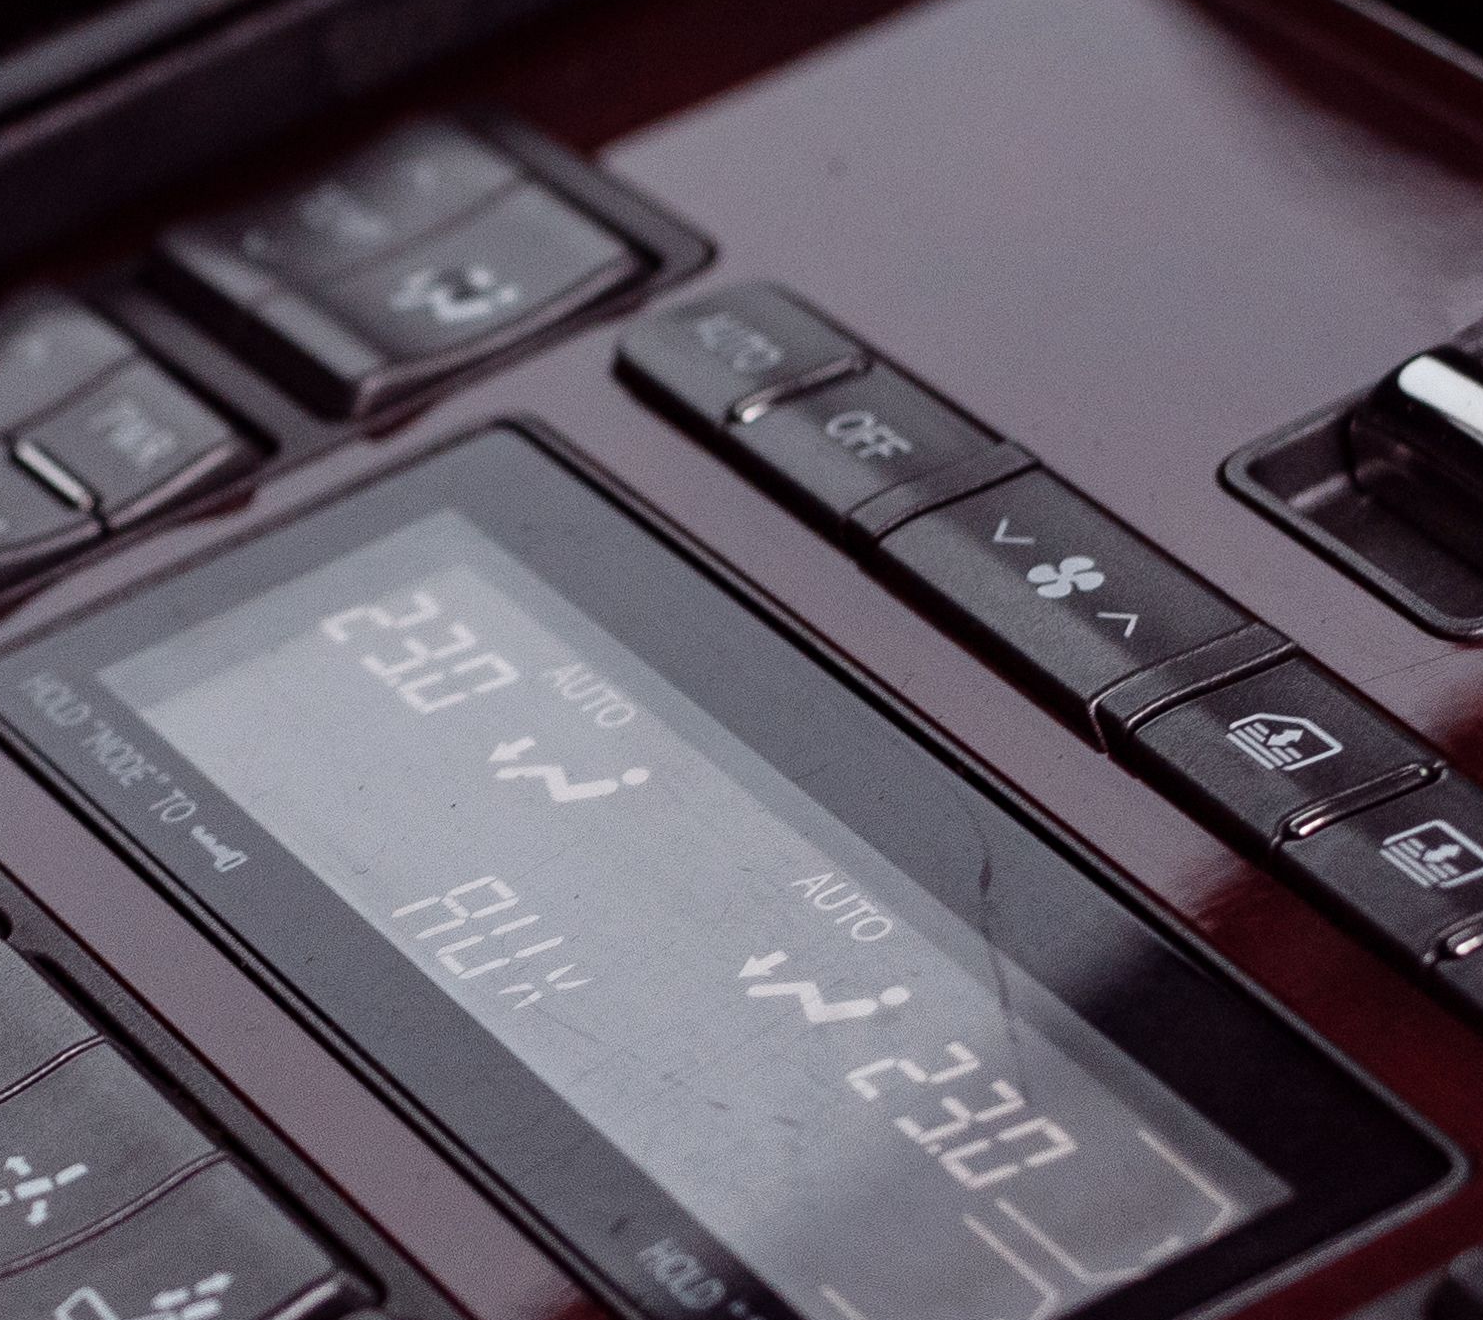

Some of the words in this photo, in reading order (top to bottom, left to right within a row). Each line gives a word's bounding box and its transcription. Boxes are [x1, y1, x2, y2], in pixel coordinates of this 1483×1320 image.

[824, 409, 913, 459] OFF
[548, 663, 636, 728] AUTO
[22, 674, 92, 728] HOLD
[148, 788, 197, 824] TO
[391, 875, 594, 1010] AUX
[791, 871, 894, 943] AUTO
[635, 1236, 728, 1311] HOLD
